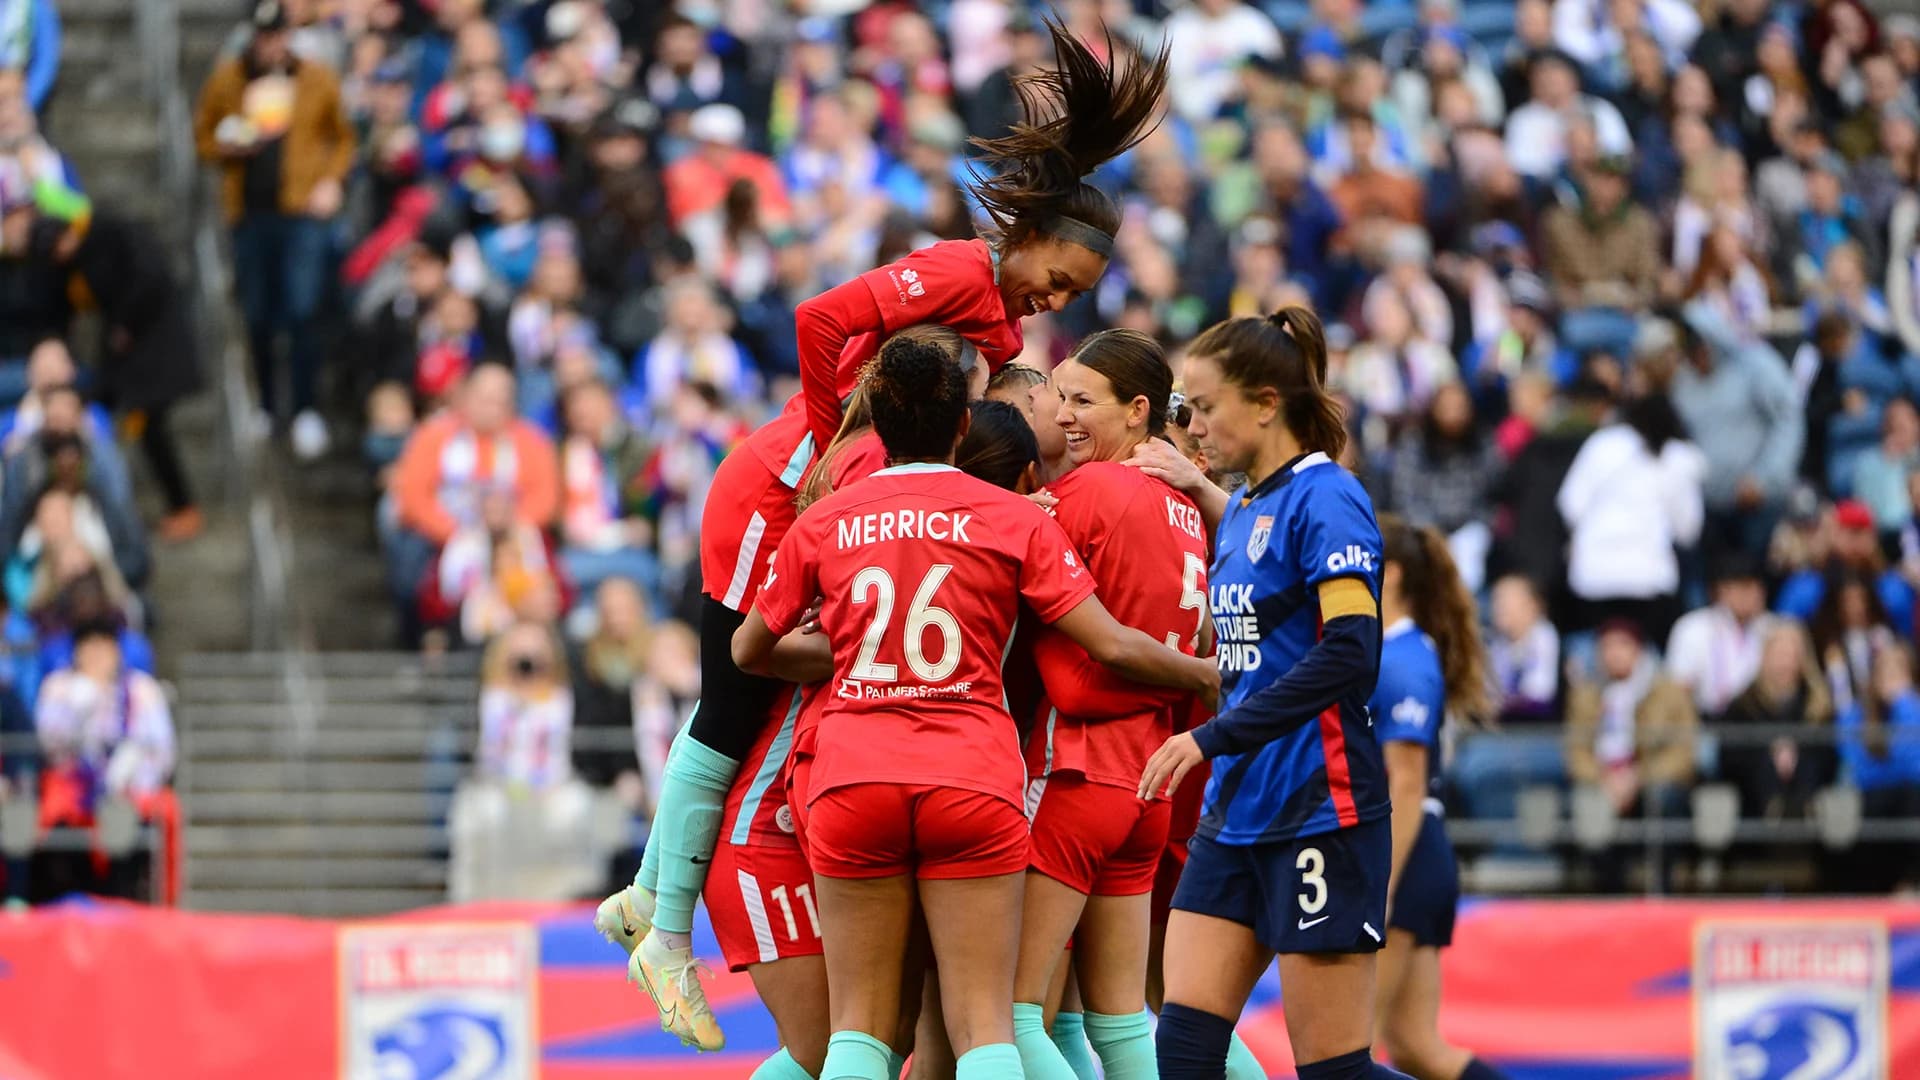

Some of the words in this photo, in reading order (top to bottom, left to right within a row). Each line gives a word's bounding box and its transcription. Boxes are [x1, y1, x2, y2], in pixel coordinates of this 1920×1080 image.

[837, 509, 973, 550] MERRICK
[849, 564, 963, 682] 26
[1209, 583, 1256, 615] LACK
[1296, 847, 1328, 914] 3
[770, 883, 822, 942] 11
